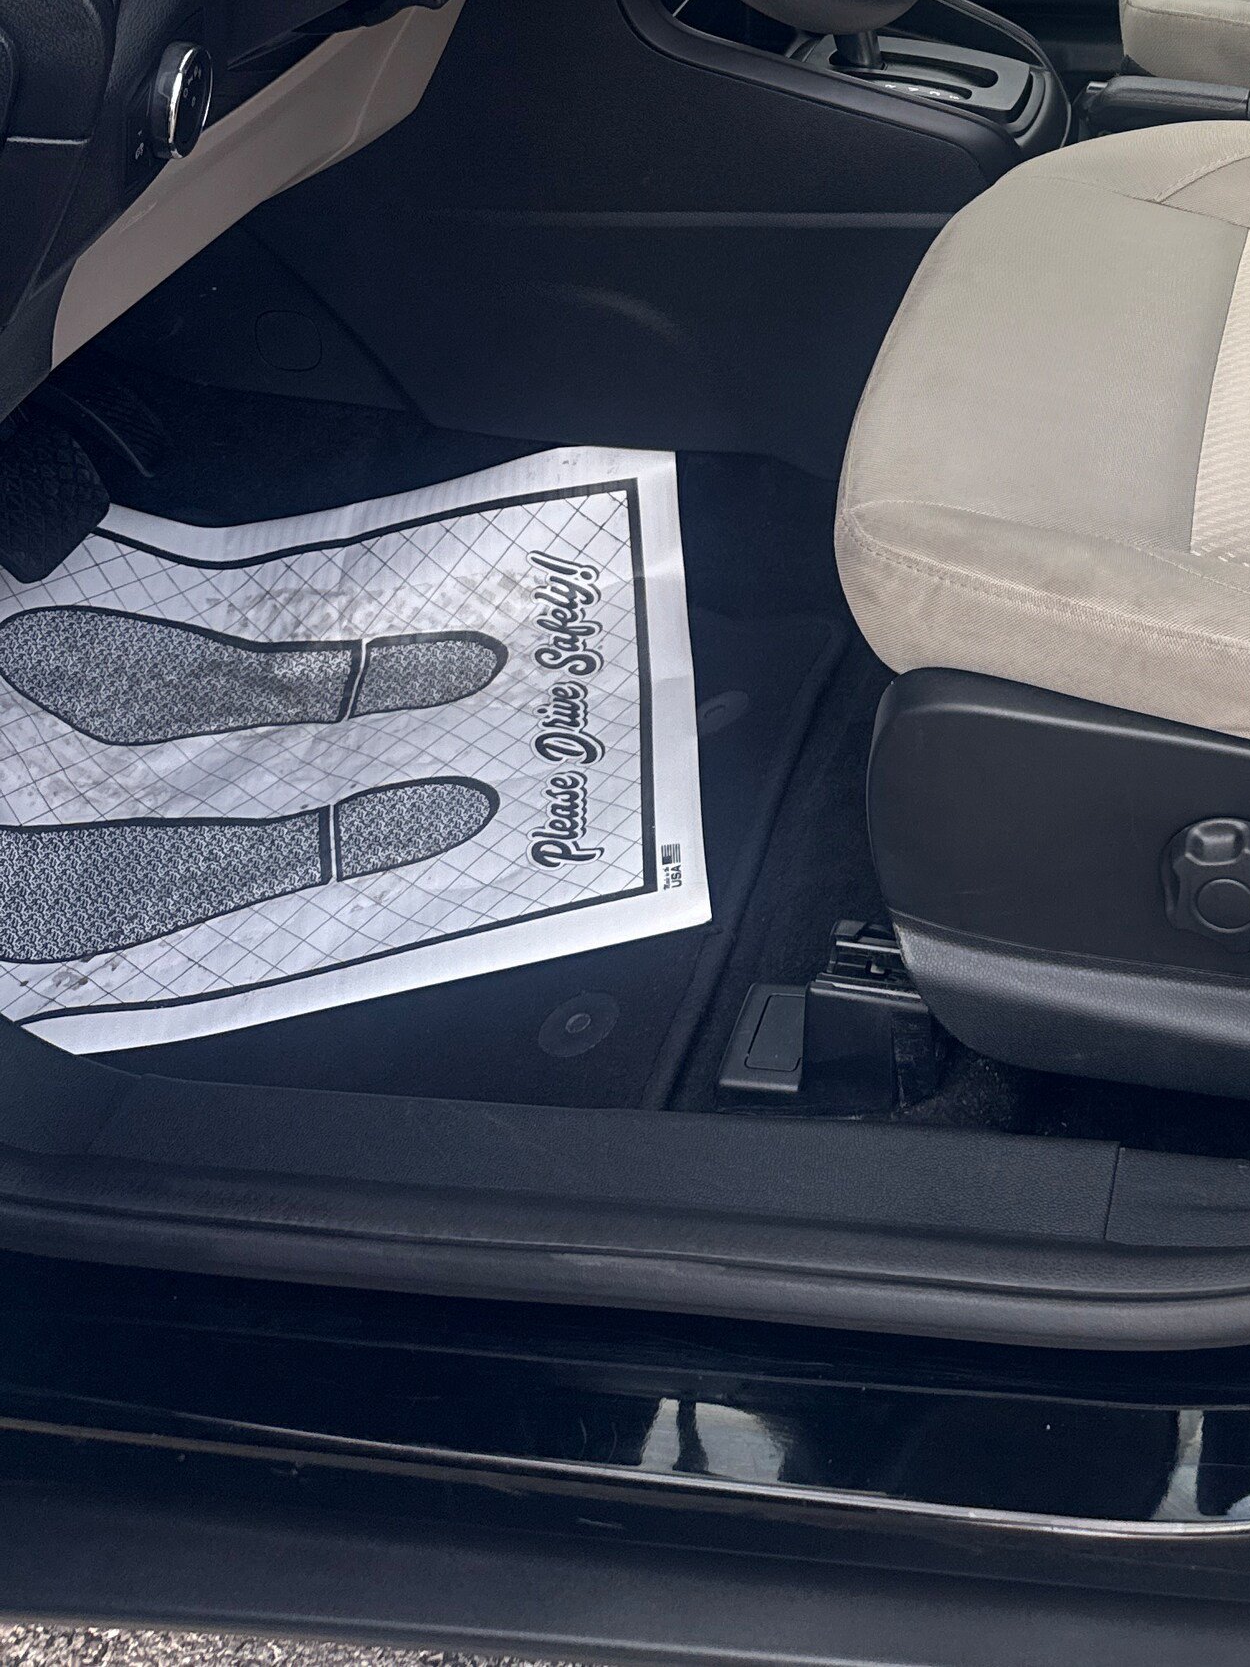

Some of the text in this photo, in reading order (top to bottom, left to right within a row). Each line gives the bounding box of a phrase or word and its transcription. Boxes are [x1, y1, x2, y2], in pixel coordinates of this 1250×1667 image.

[528, 550, 605, 869] Please Drive Safely!
[671, 865, 682, 888] USA
